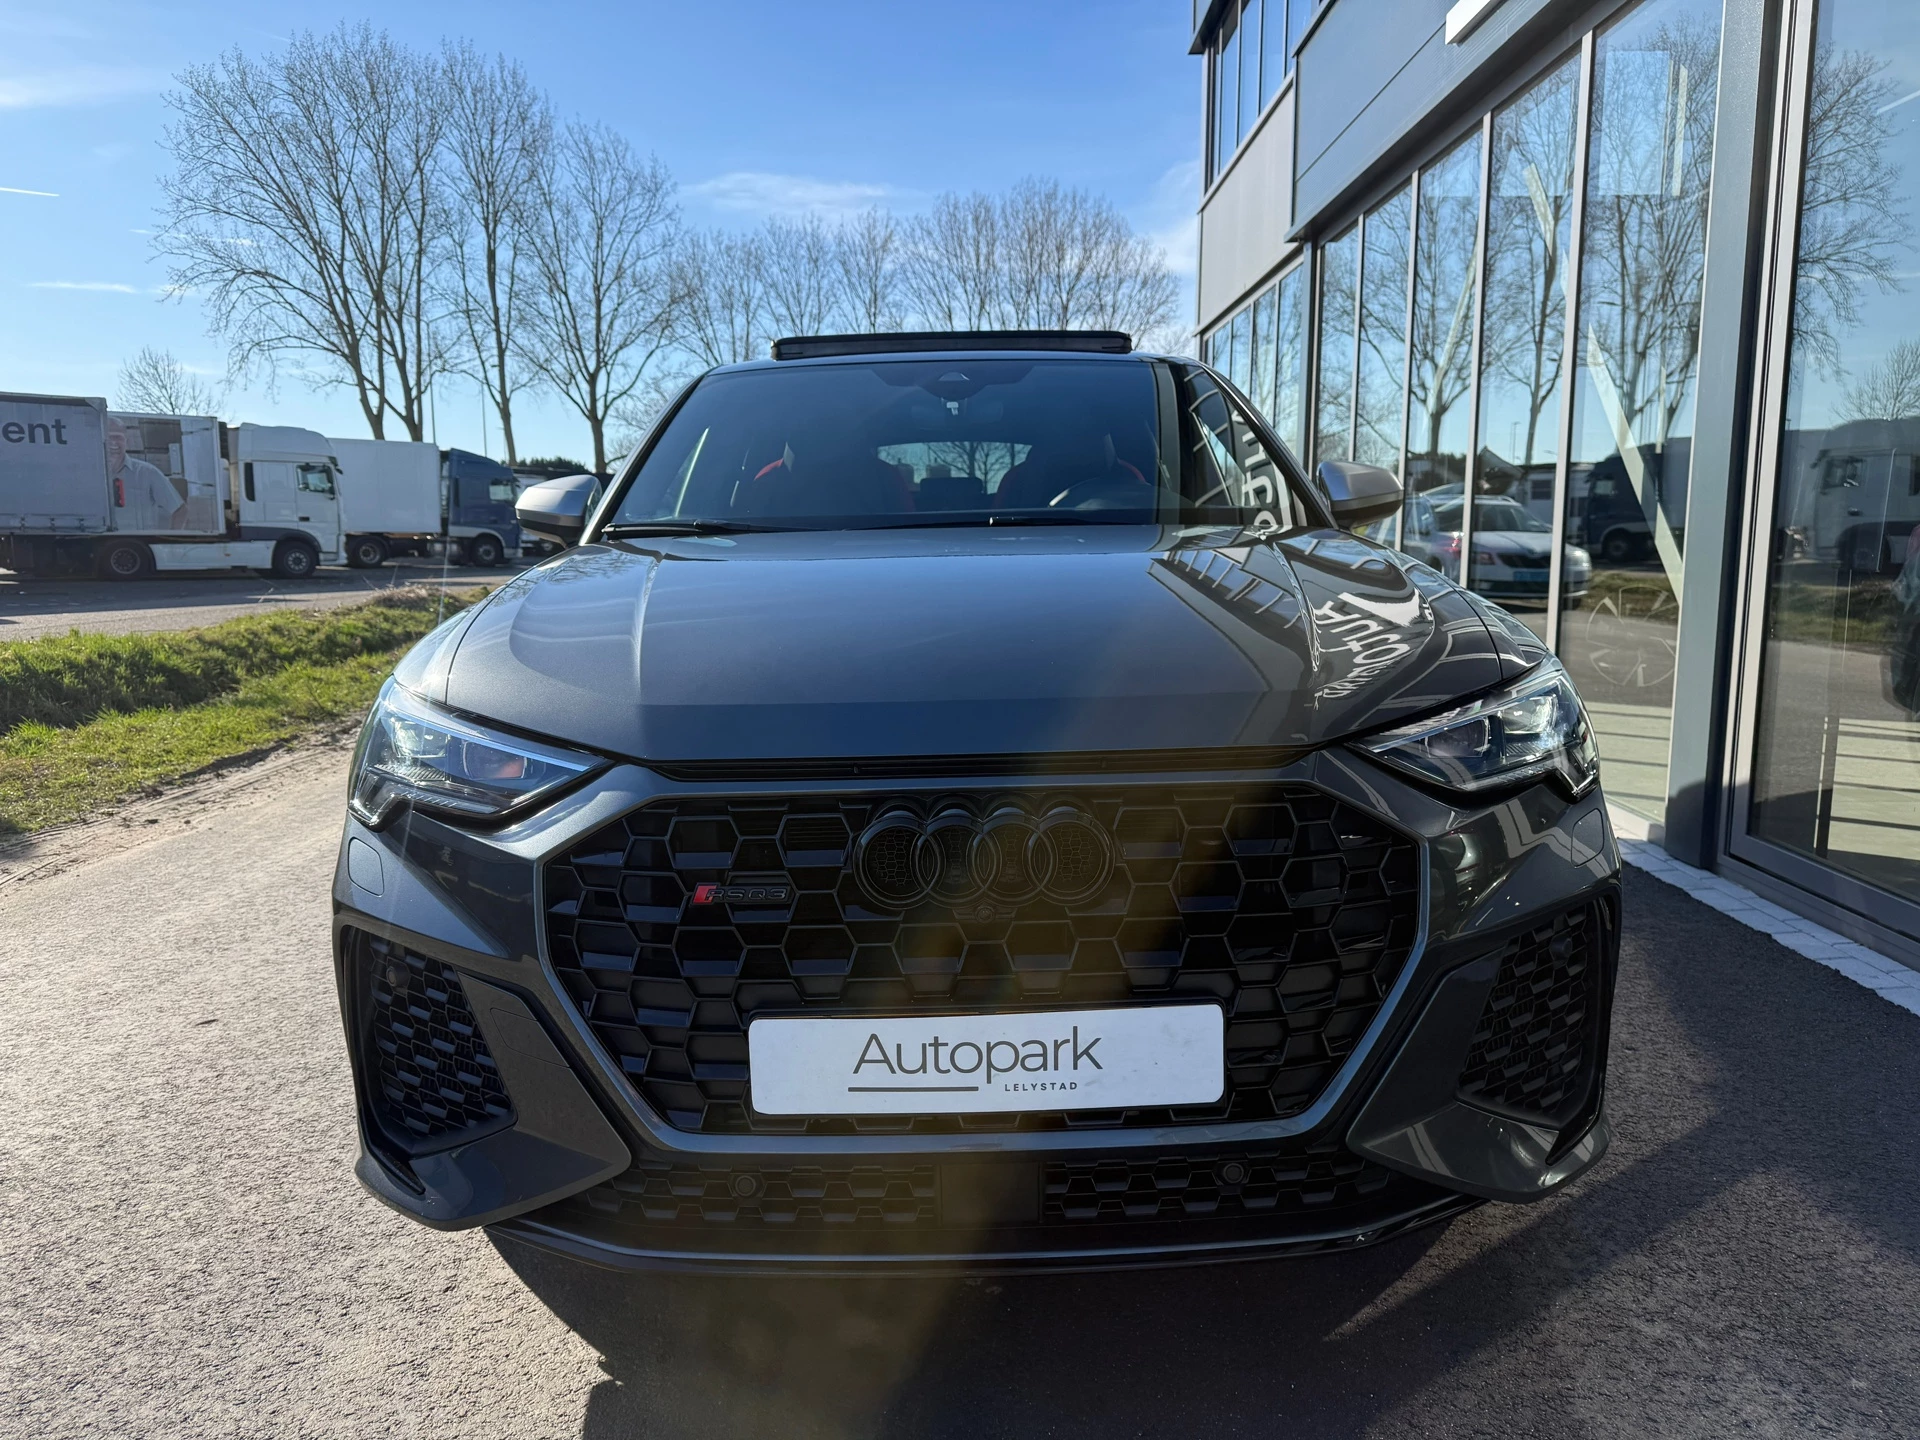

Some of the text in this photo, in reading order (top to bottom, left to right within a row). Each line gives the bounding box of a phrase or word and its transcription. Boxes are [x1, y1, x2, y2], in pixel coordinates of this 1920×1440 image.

[2, 418, 68, 445] ent
[852, 1025, 1103, 1084] Autopark
[1004, 1081, 1078, 1092] LELYSTAD
